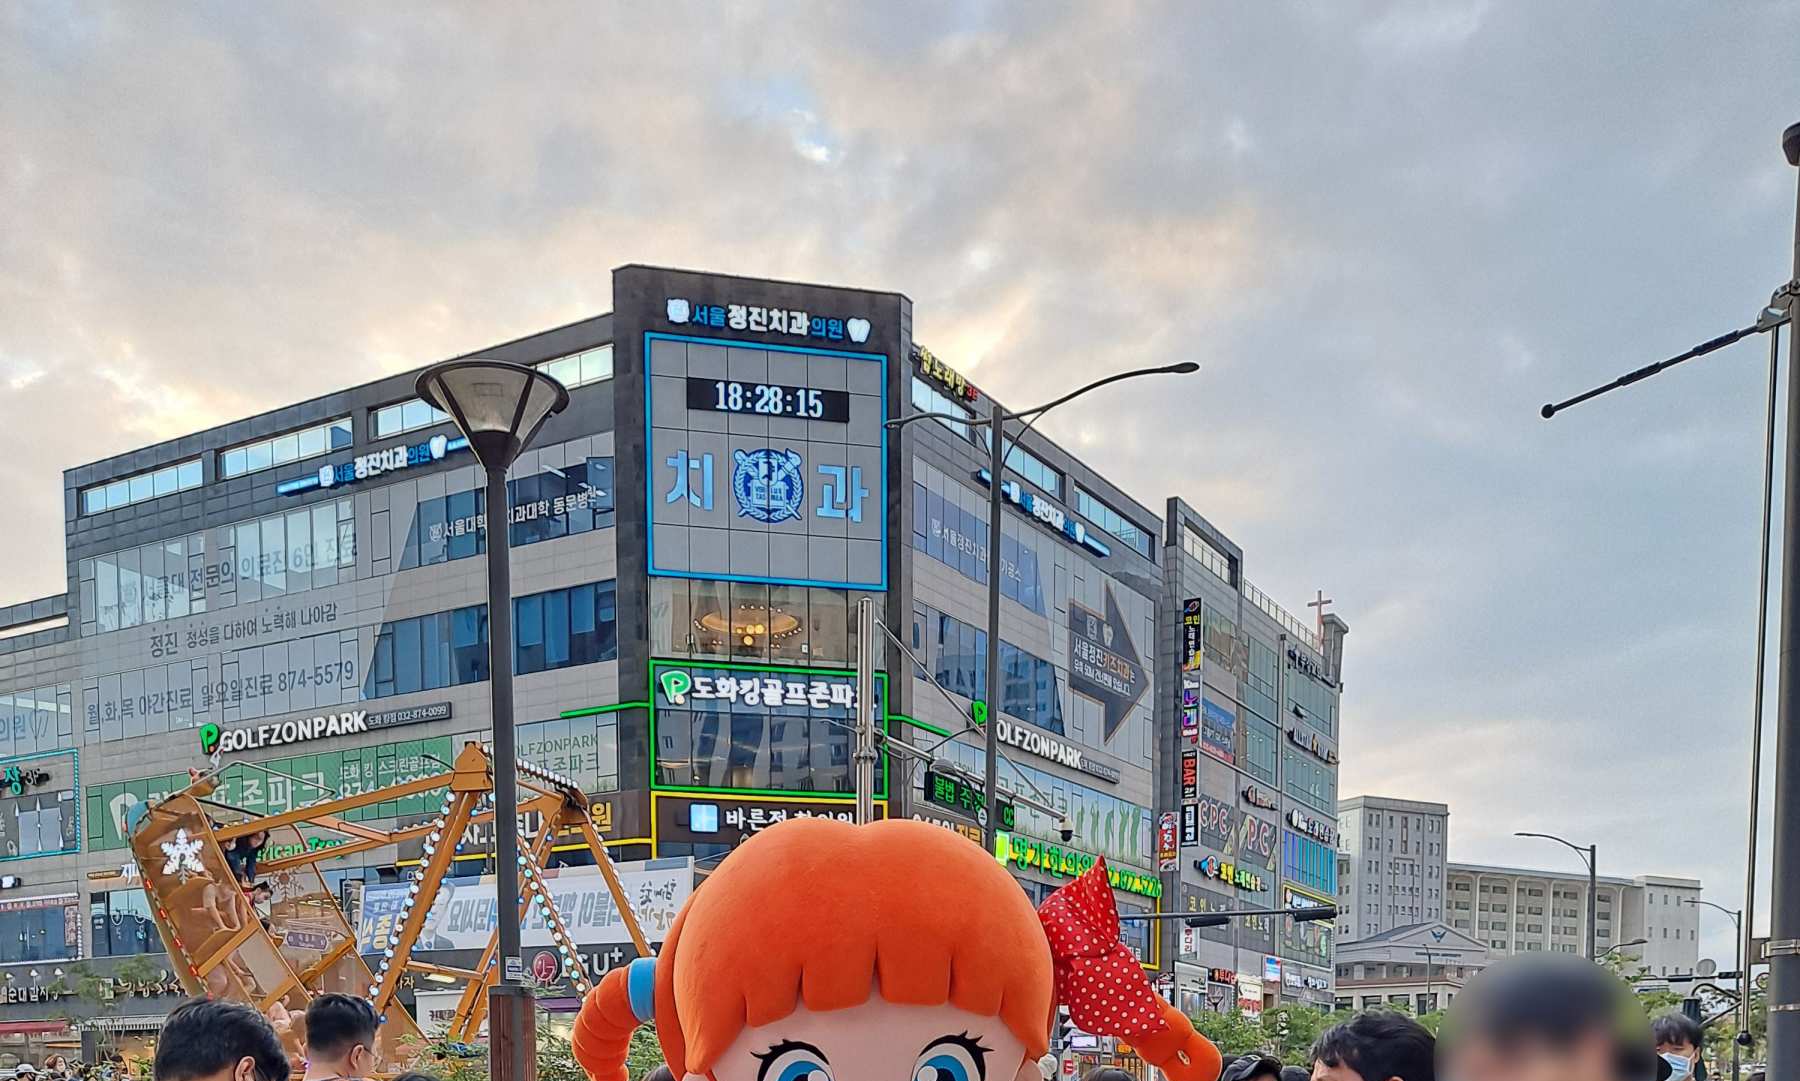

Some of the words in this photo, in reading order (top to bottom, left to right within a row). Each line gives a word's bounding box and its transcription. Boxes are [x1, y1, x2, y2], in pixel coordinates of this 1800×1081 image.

[715, 381, 824, 419] 18:28:15
[150, 631, 178, 658] 정진
[186, 626, 220, 649] 정성을
[223, 618, 257, 641] 다하여
[261, 610, 296, 633] 노력해
[301, 601, 338, 625] 나아감
[138, 687, 192, 716] 야간진료
[278, 660, 355, 691] 874-5579
[219, 710, 367, 752] GOLFZONPARK
[518, 733, 598, 757] LFZONPARK
[996, 719, 1083, 770] OLFZONPARK
[934, 774, 955, 806] 불법
